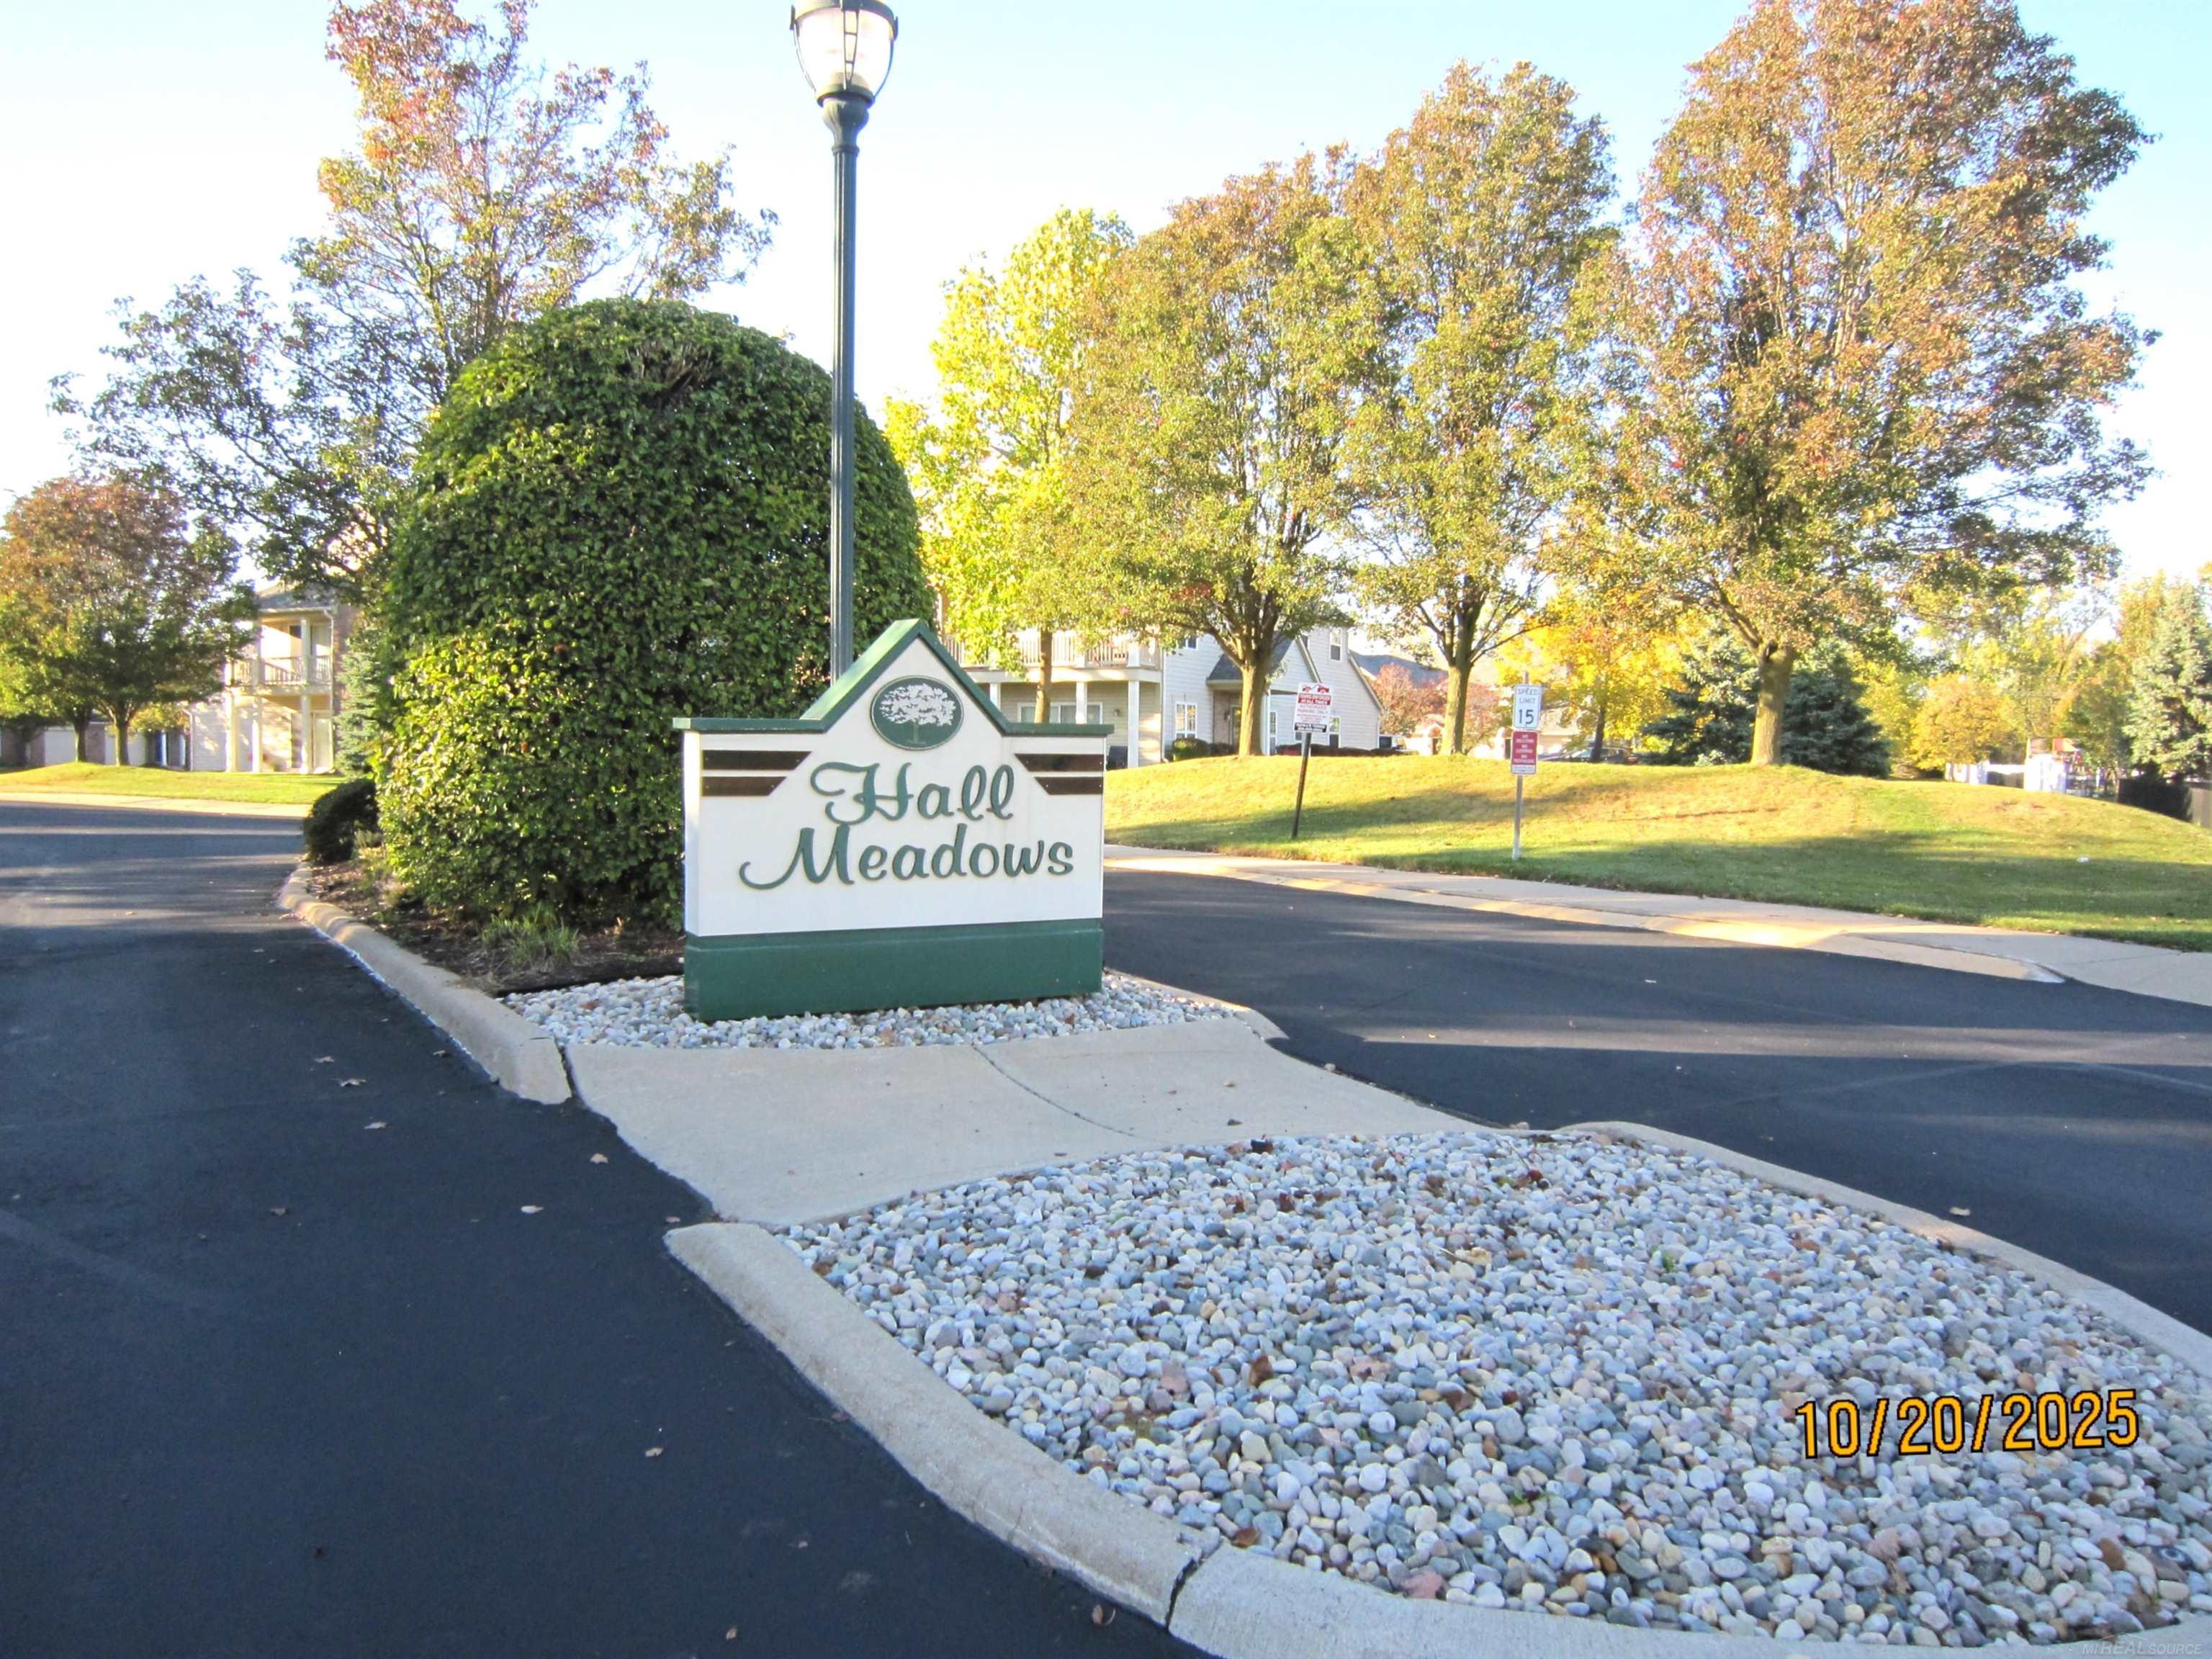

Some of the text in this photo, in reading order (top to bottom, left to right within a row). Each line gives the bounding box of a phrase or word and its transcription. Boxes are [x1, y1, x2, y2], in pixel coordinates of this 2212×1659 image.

[1519, 709, 1534, 724] 15
[811, 762, 1015, 824] Hall
[739, 823, 1074, 890] Meadows
